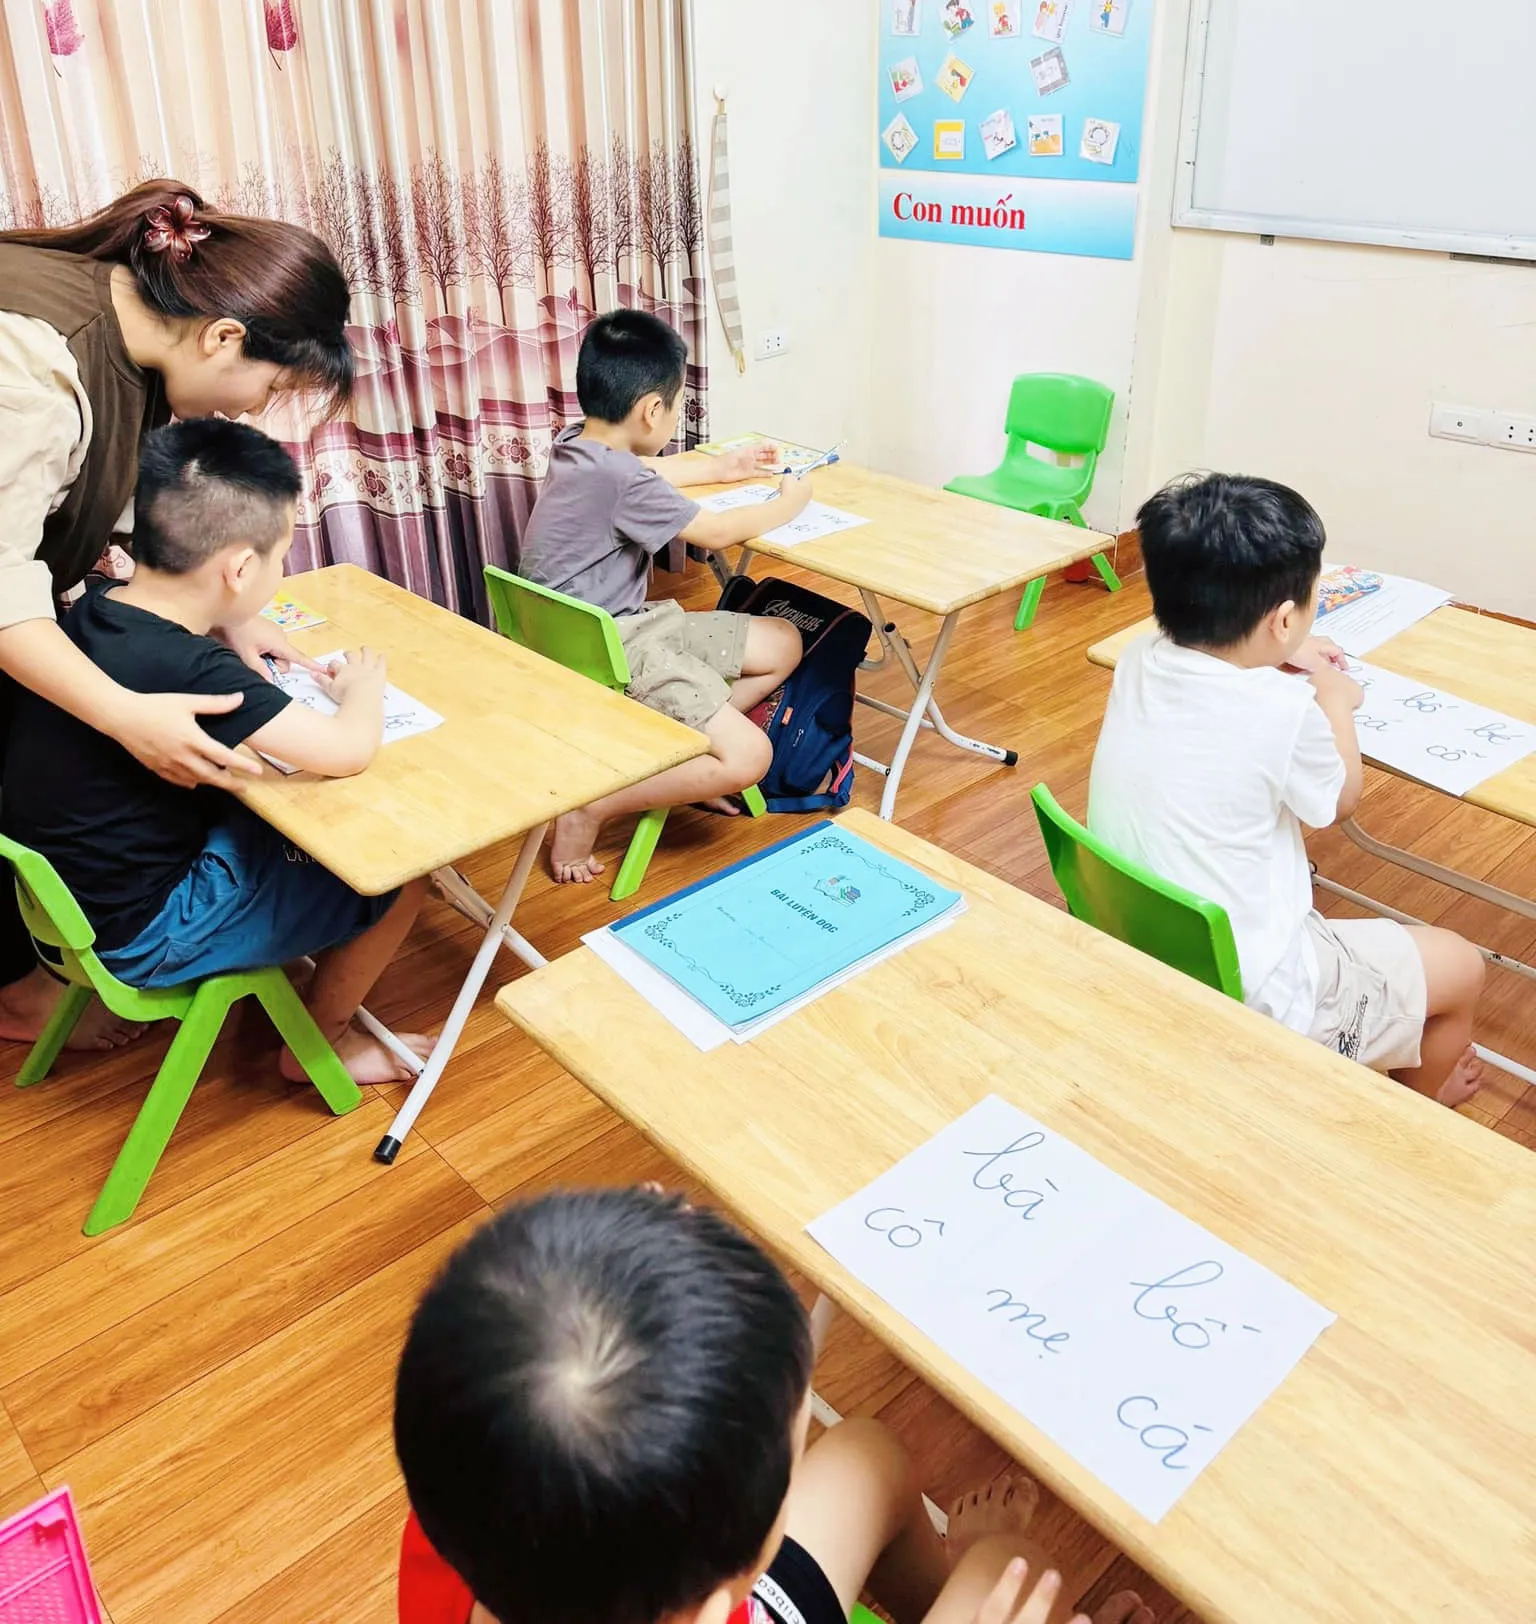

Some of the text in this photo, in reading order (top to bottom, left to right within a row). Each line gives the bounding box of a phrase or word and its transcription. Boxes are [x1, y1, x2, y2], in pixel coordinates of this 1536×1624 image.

[893, 192, 1025, 230] Con muốn
[761, 599, 824, 632] AVENGERS
[963, 1131, 1059, 1220] bà
[864, 1207, 945, 1248] cô
[986, 1289, 1070, 1360] mẹ
[1129, 1260, 1262, 1349] bố
[1116, 1395, 1214, 1469] cá
